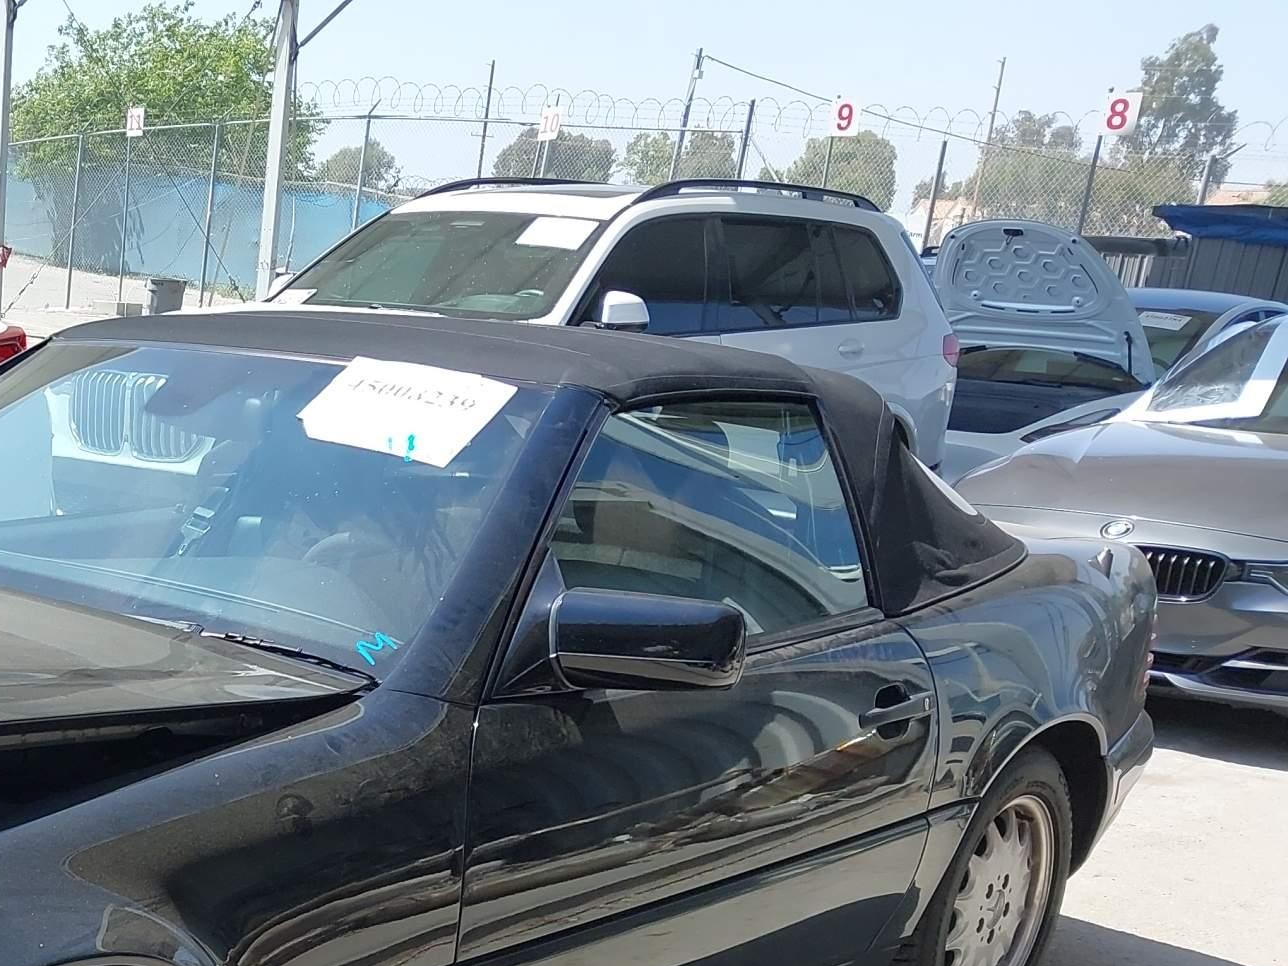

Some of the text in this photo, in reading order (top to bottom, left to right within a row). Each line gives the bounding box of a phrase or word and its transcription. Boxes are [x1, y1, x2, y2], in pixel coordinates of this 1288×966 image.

[540, 113, 560, 133] 10
[837, 103, 854, 130] 9
[1106, 98, 1129, 130] 8
